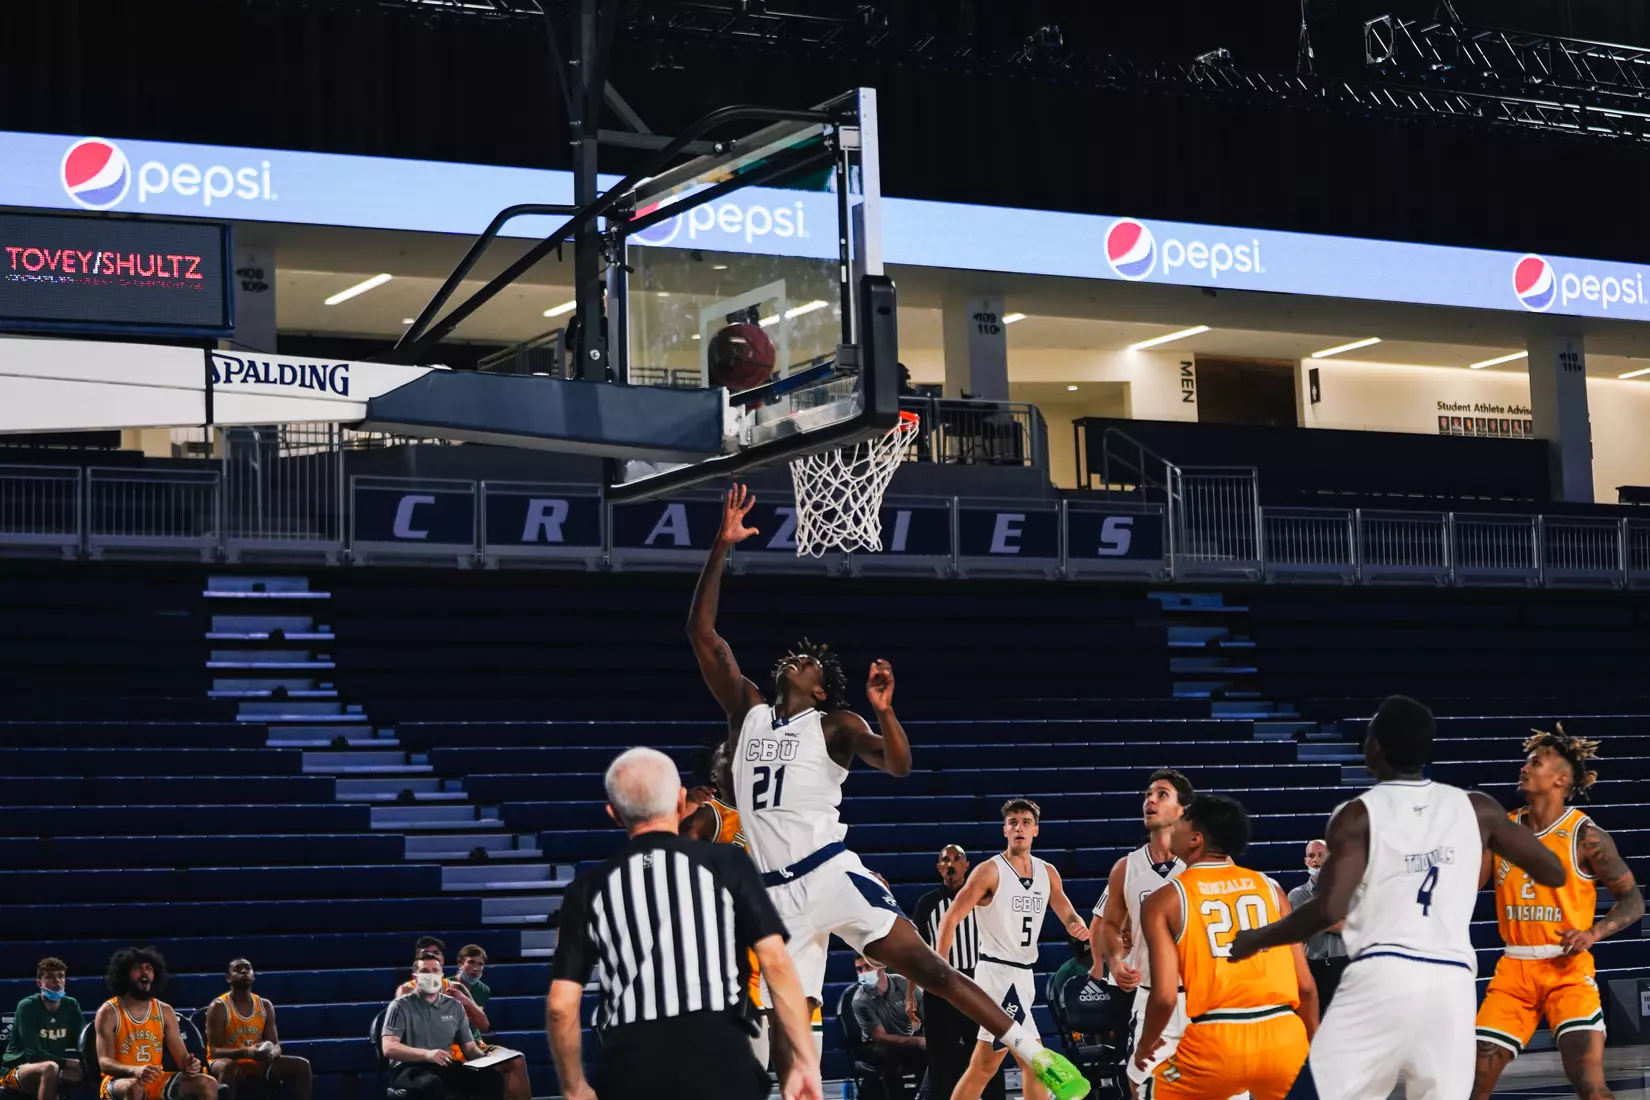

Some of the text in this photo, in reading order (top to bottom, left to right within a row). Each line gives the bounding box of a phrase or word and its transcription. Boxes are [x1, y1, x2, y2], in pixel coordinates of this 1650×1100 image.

[138, 160, 271, 207] pepsi
[689, 200, 805, 244] pepsi
[5, 246, 204, 279] TOVEY/SHULTZ
[1162, 238, 1260, 279] pepsi
[1561, 272, 1644, 310] pepsi
[1180, 360, 1195, 403] MEN
[1437, 401, 1471, 412] Student
[1474, 403, 1505, 414] Athlete
[745, 739, 799, 761] CBU
[752, 765, 785, 812] 21
[1012, 896, 1043, 914] CBU
[1197, 878, 1257, 895] GONZALEZ
[1416, 866, 1439, 916] 4
[1021, 916, 1032, 947] 5
[1201, 894, 1268, 958] 20
[1079, 991, 1111, 1002] adidas
